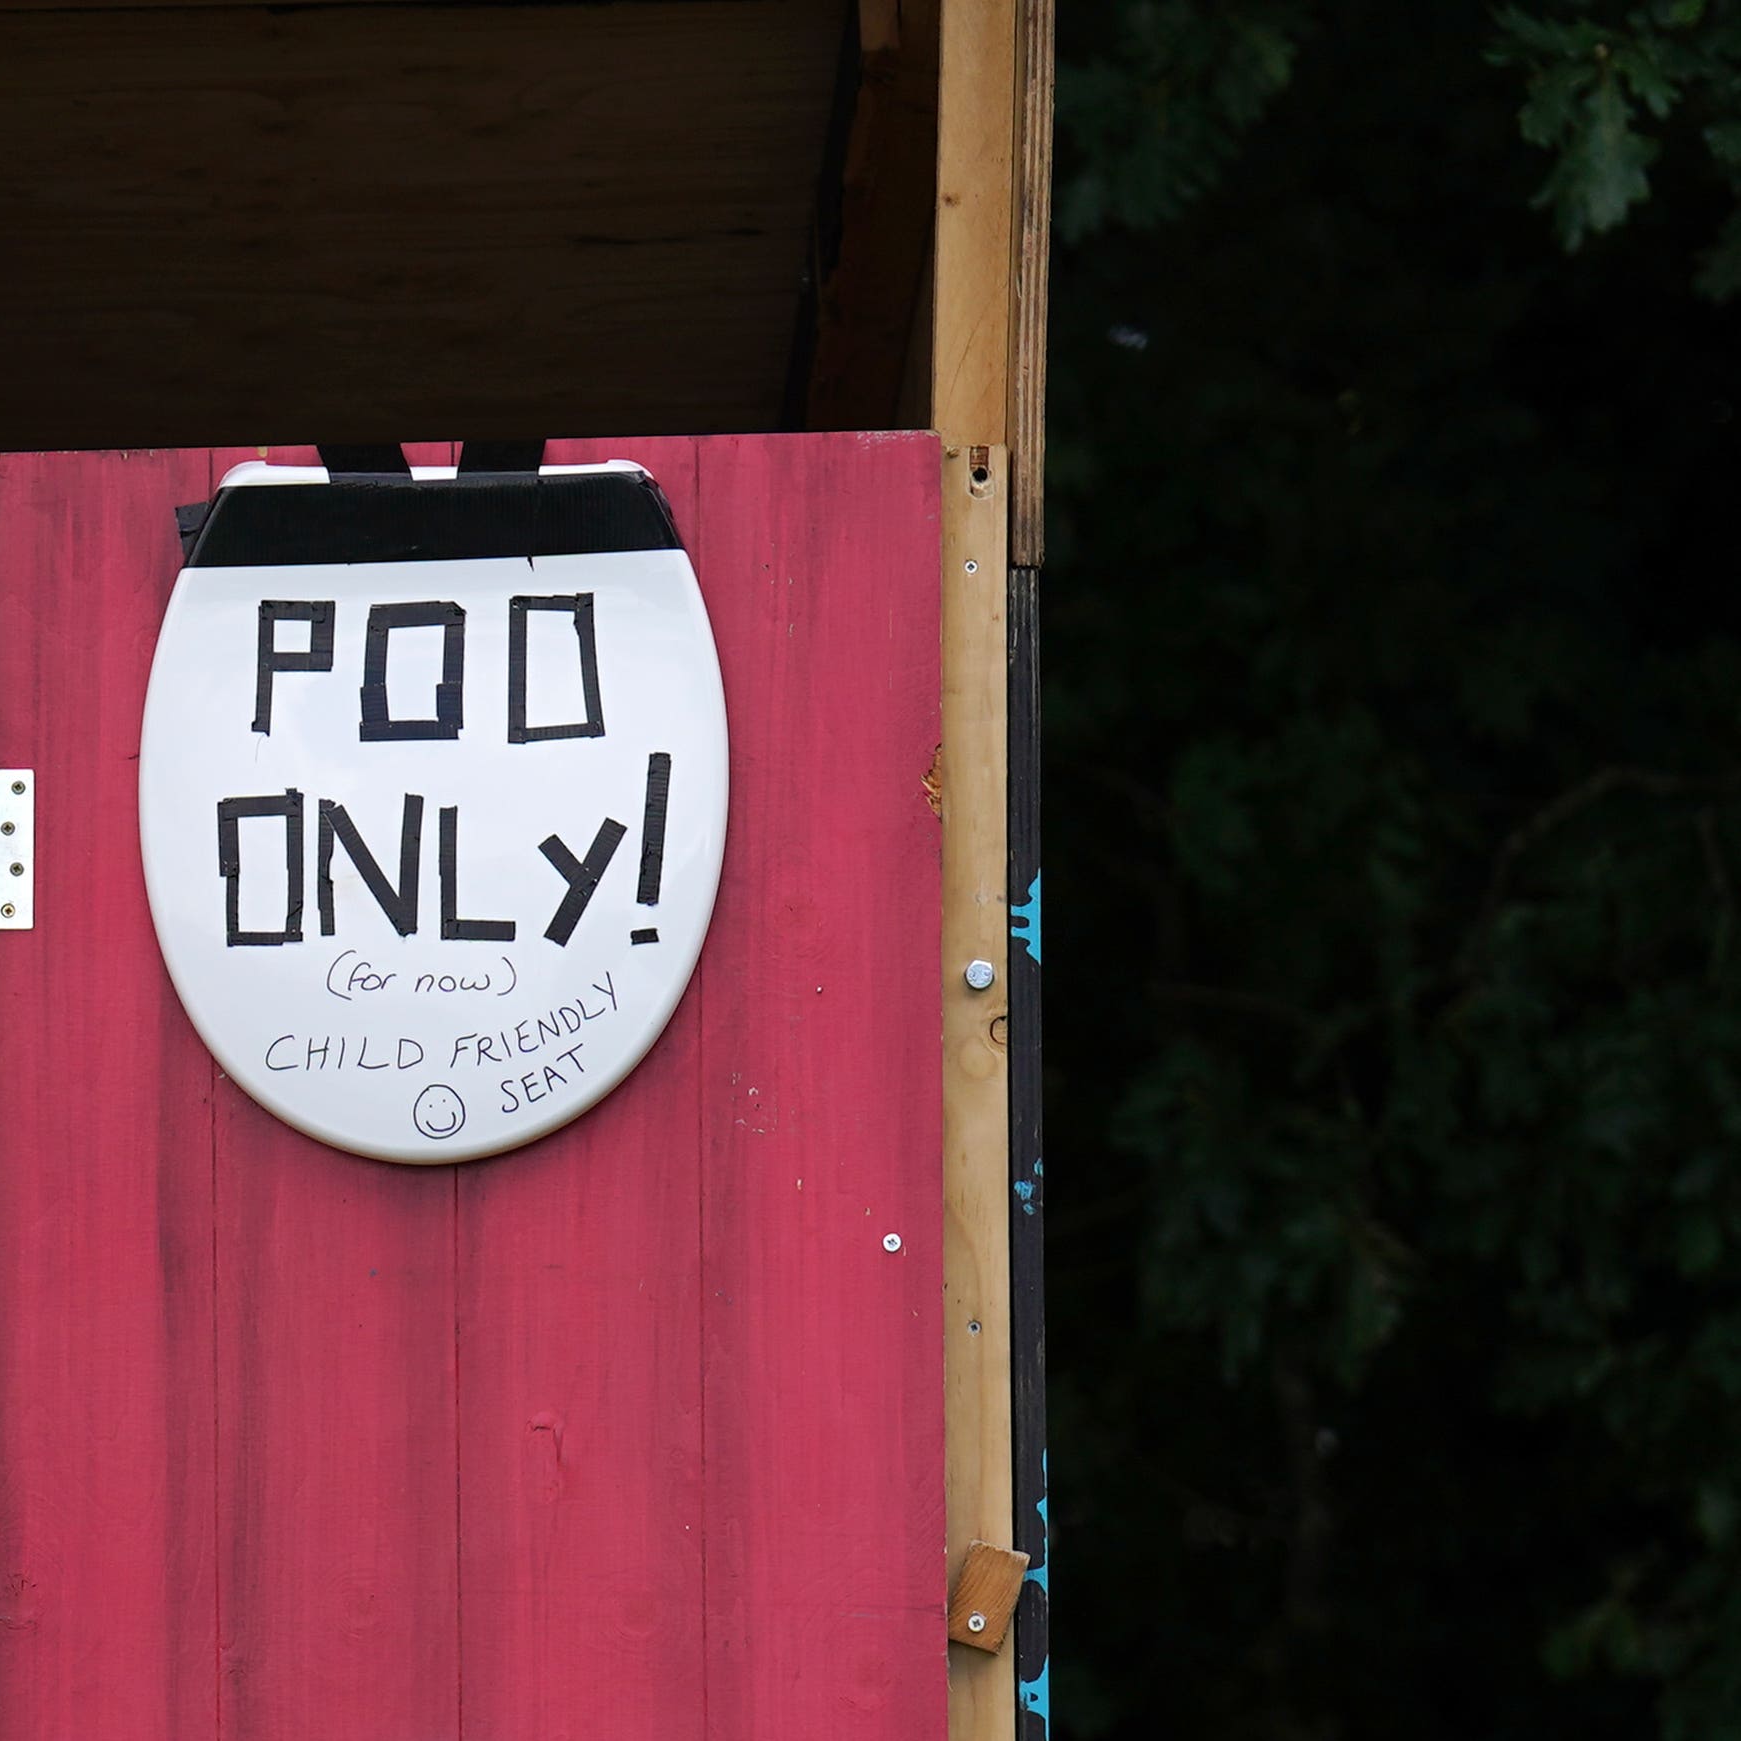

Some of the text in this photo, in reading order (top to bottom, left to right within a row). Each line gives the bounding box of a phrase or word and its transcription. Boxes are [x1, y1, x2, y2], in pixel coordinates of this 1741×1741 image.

[251, 592, 606, 745] POO
[217, 752, 672, 948] ONLY!
[265, 970, 621, 1072] CHILD FRIENDLY
[326, 949, 518, 1001] (for now)
[501, 1043, 588, 1116] SEAT
